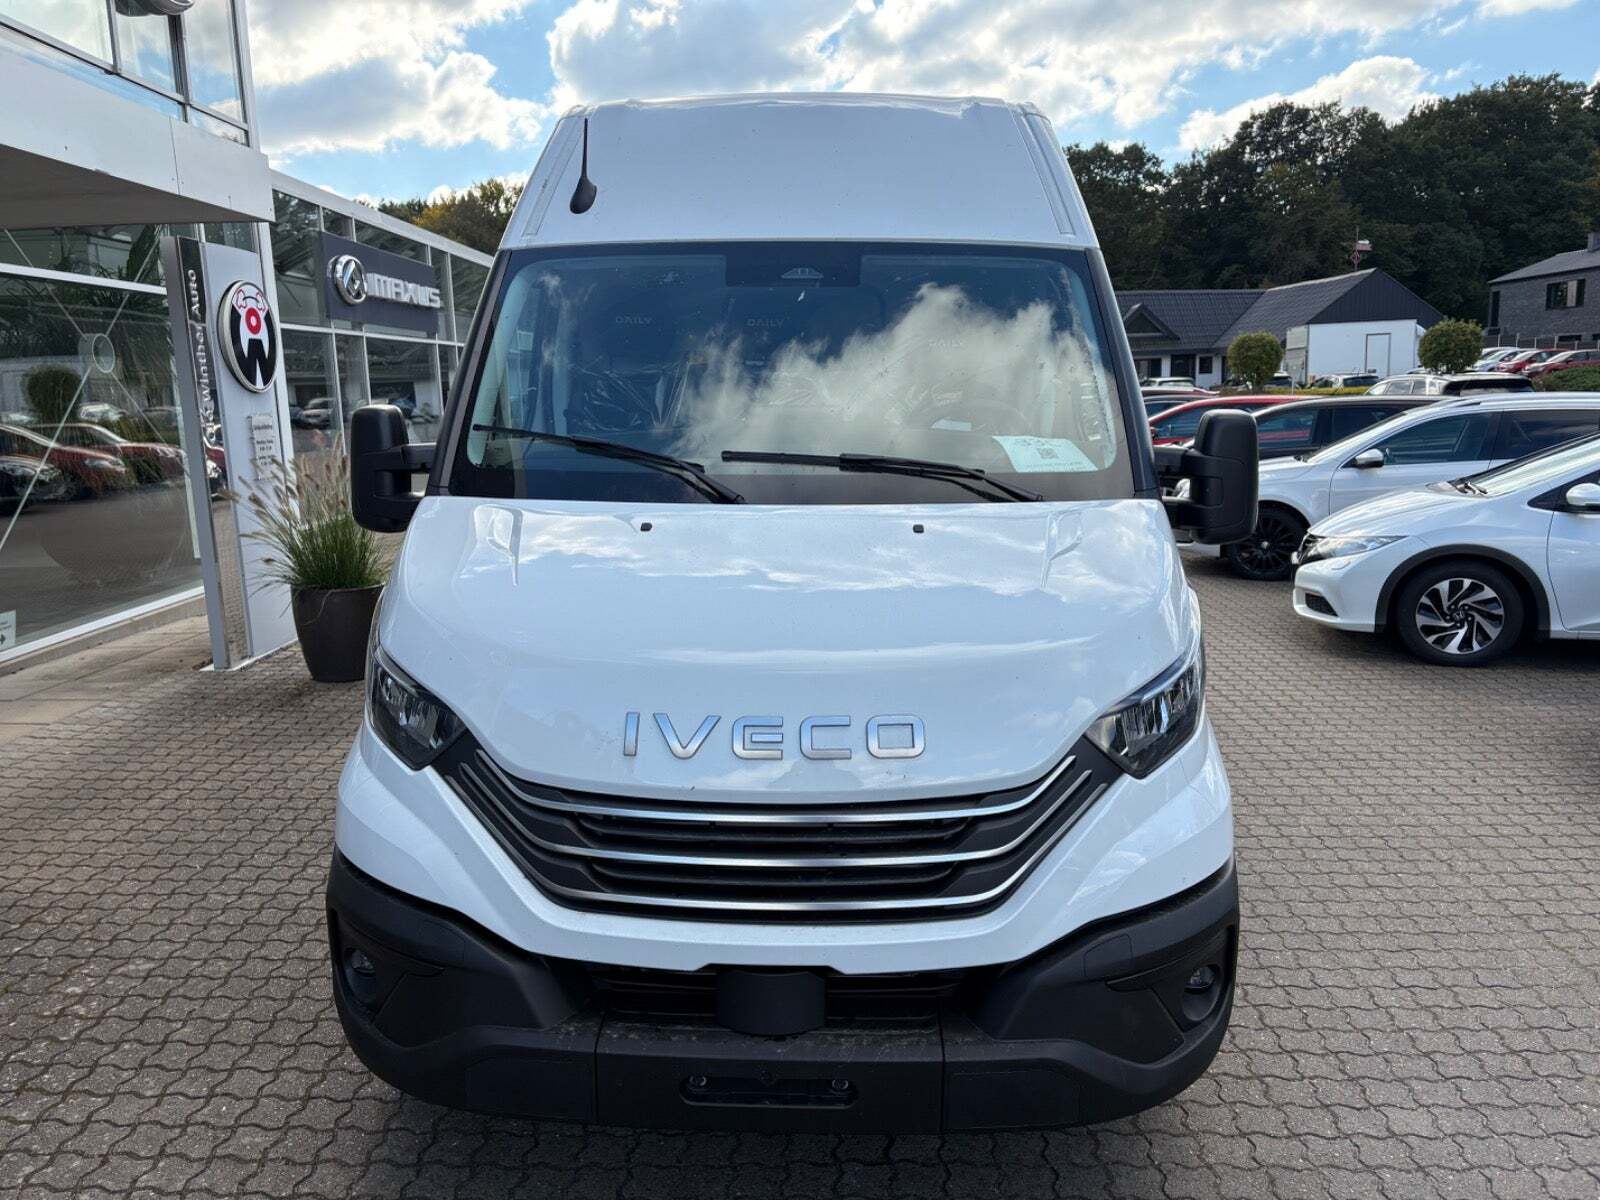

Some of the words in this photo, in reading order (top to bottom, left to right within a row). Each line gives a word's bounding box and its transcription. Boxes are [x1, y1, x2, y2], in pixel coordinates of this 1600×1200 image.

[366, 272, 441, 309] MAXUS
[747, 317, 785, 328] DAILY
[623, 711, 926, 760] IVECO
